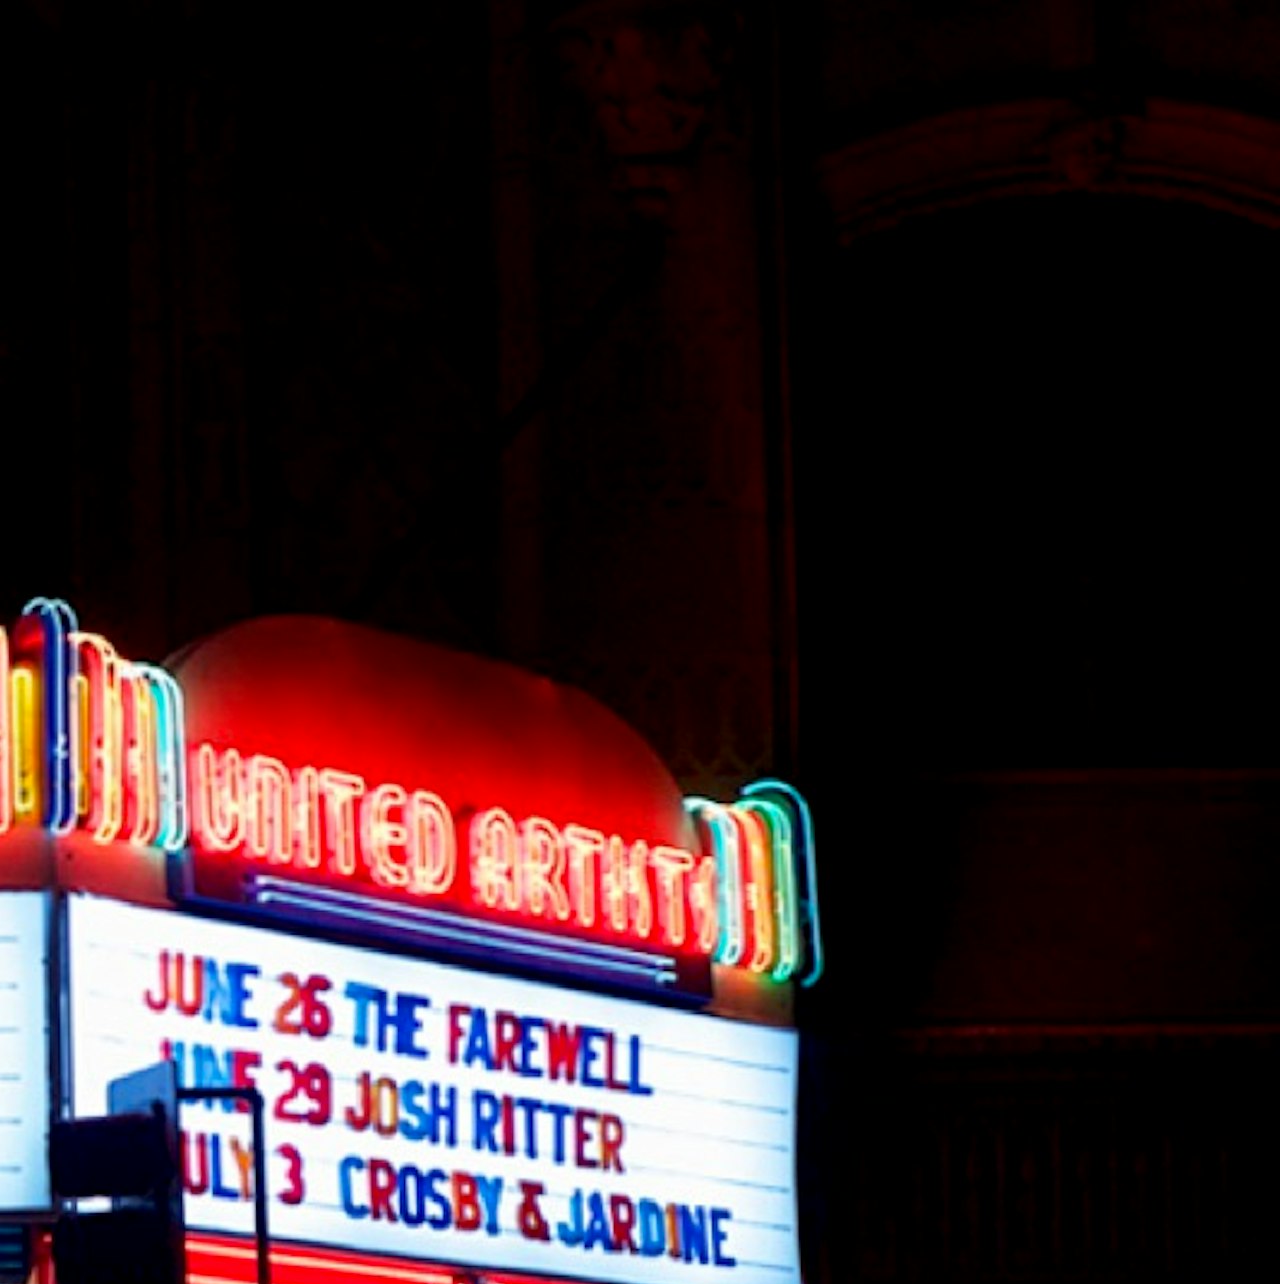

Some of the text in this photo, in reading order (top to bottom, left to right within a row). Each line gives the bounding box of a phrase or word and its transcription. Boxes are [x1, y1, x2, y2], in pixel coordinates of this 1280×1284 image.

[192, 742, 718, 954] UNITED ARTISTS
[144, 949, 654, 1096] JUNE 26 THE FAREWELL
[273, 1059, 332, 1126] 29
[344, 1070, 458, 1149] JOSH
[472, 1088, 626, 1174] RITTER
[179, 1130, 737, 1268] ULY 3 CROSBY & JARDINE
